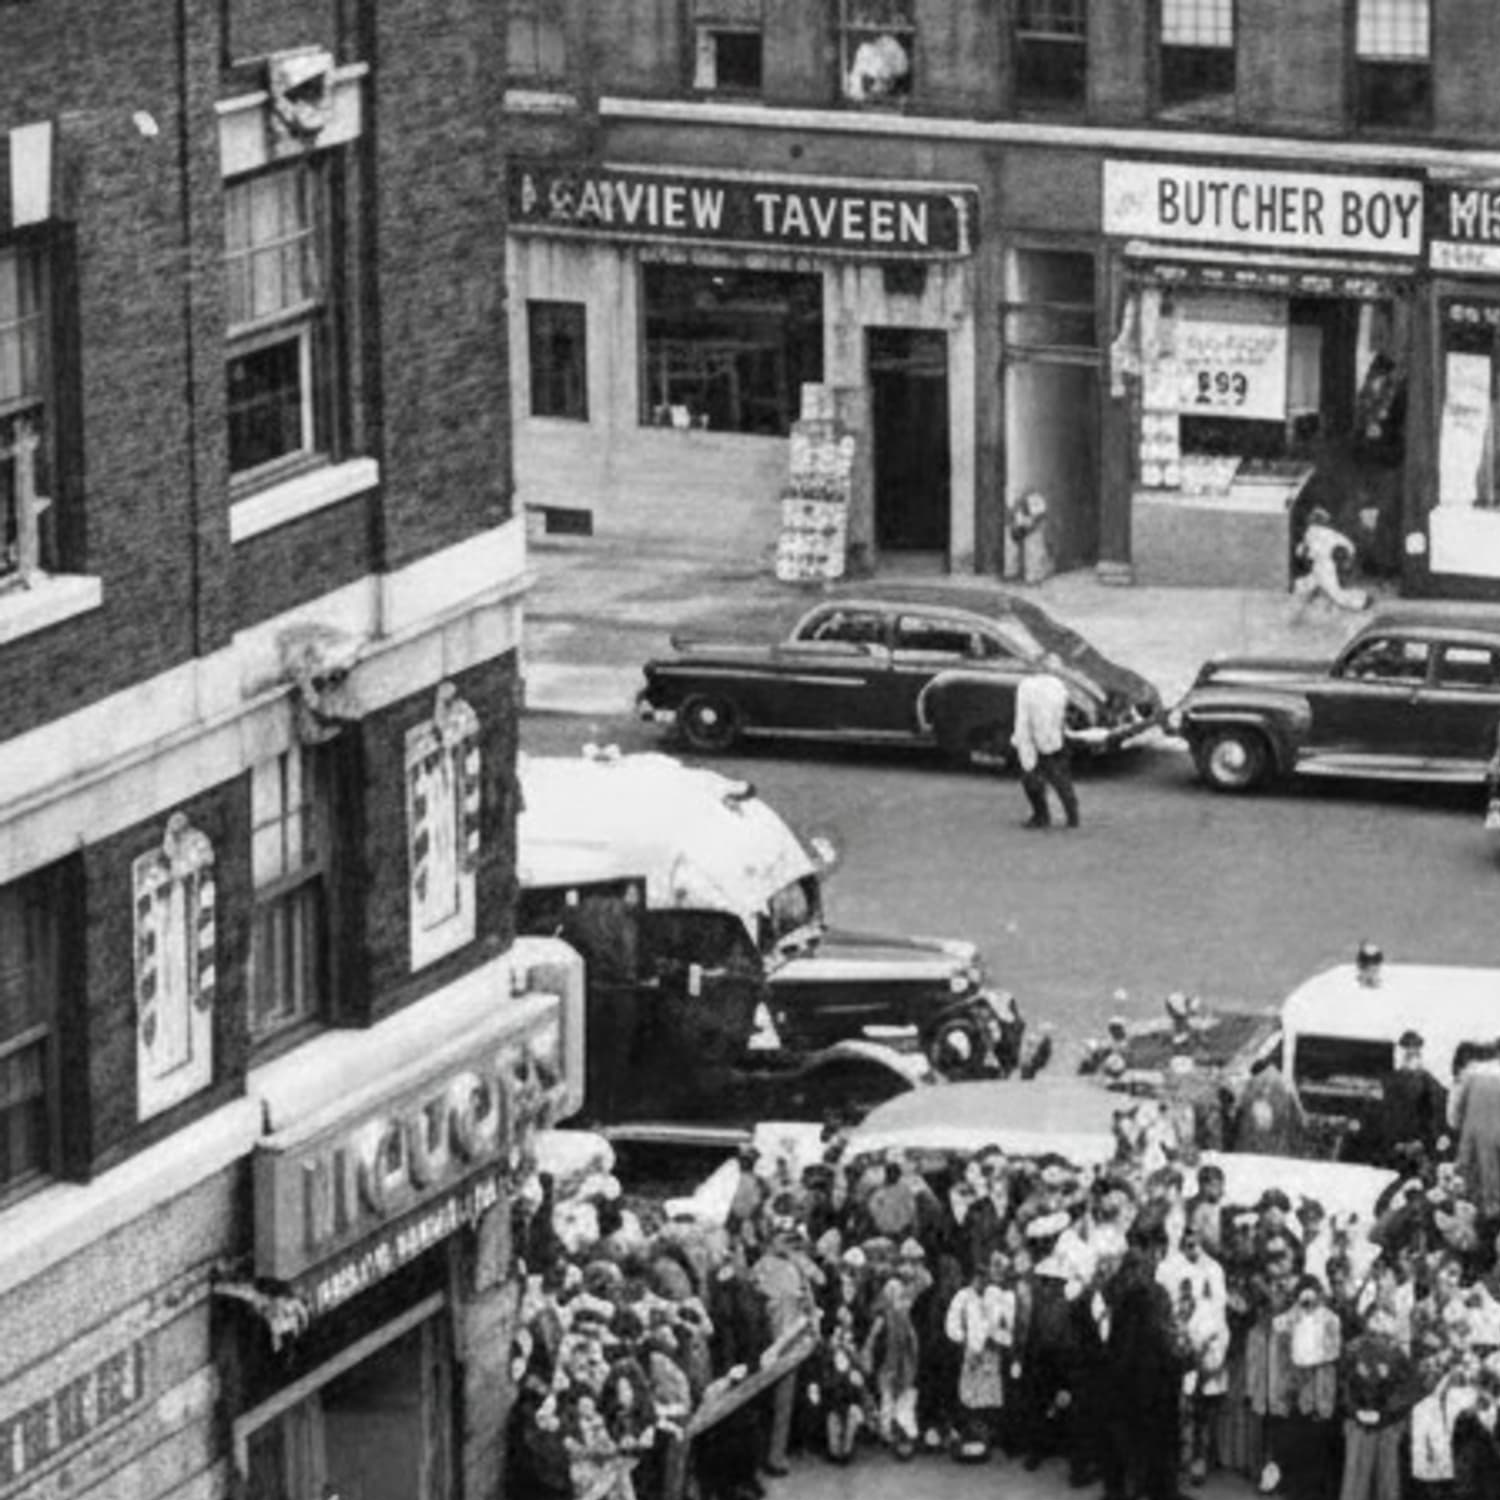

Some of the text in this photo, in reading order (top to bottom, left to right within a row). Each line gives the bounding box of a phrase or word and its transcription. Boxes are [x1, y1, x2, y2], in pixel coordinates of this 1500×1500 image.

[755, 193, 928, 245] TAVEEN
[1157, 177, 1418, 241] BUTCHER BOY
